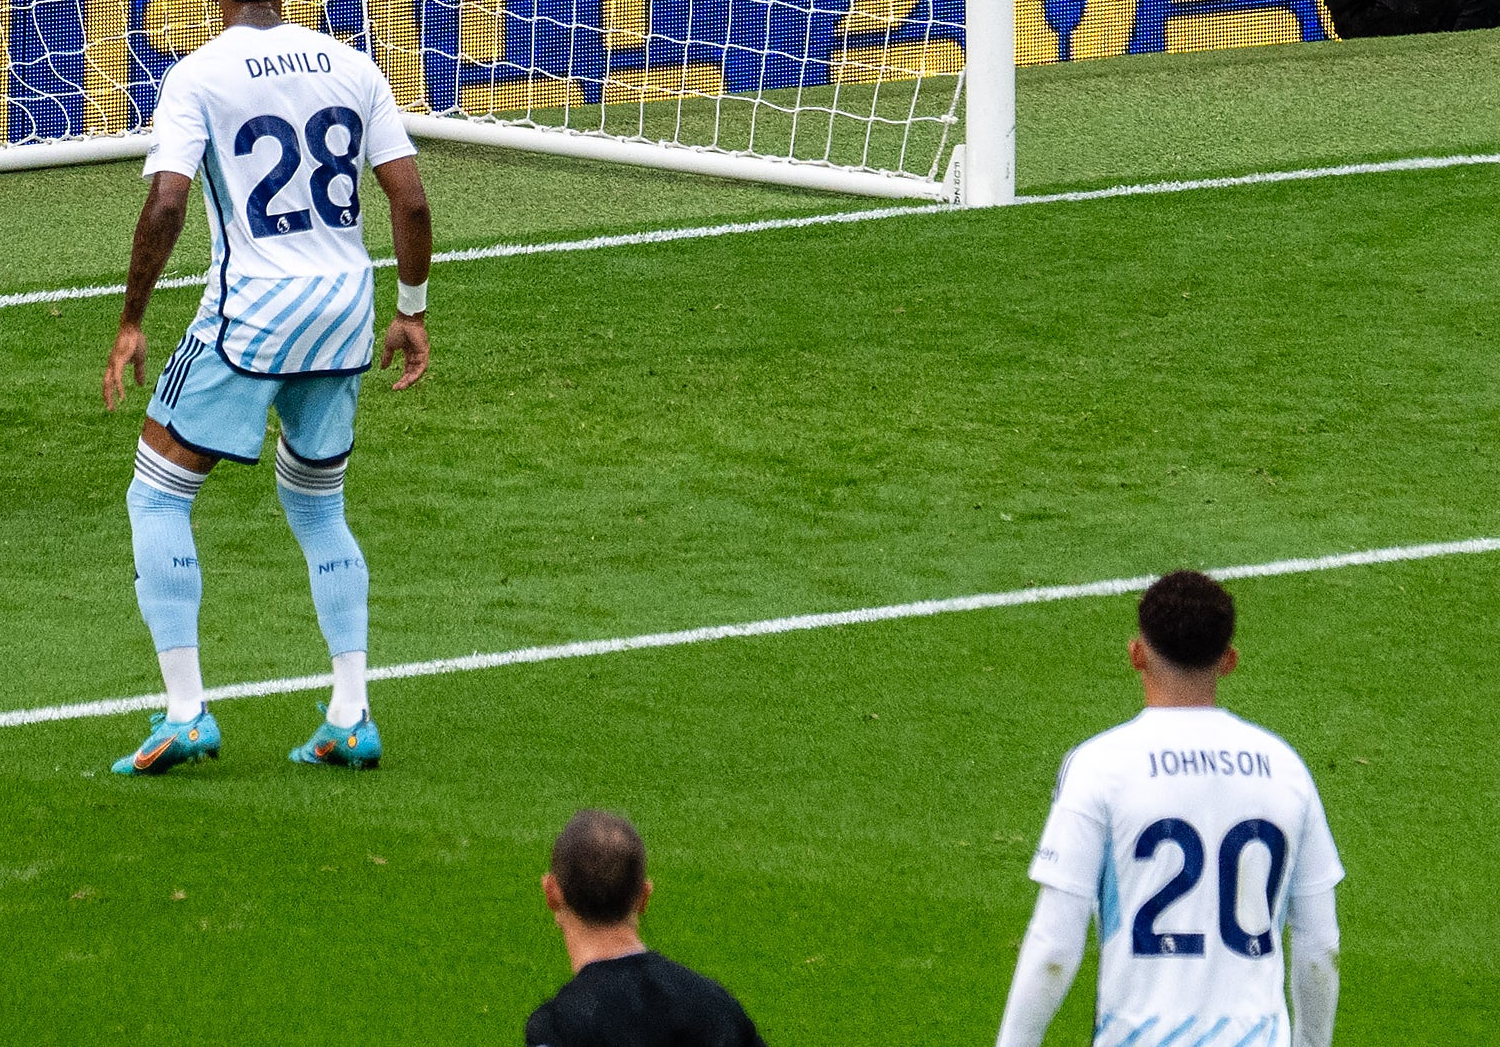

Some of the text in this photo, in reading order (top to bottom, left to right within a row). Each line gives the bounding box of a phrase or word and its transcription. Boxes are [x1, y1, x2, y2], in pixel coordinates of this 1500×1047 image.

[245, 52, 332, 79] DANILO
[233, 105, 364, 240] 28
[1149, 749, 1272, 779] JOHNSON
[1133, 816, 1289, 960] 20
